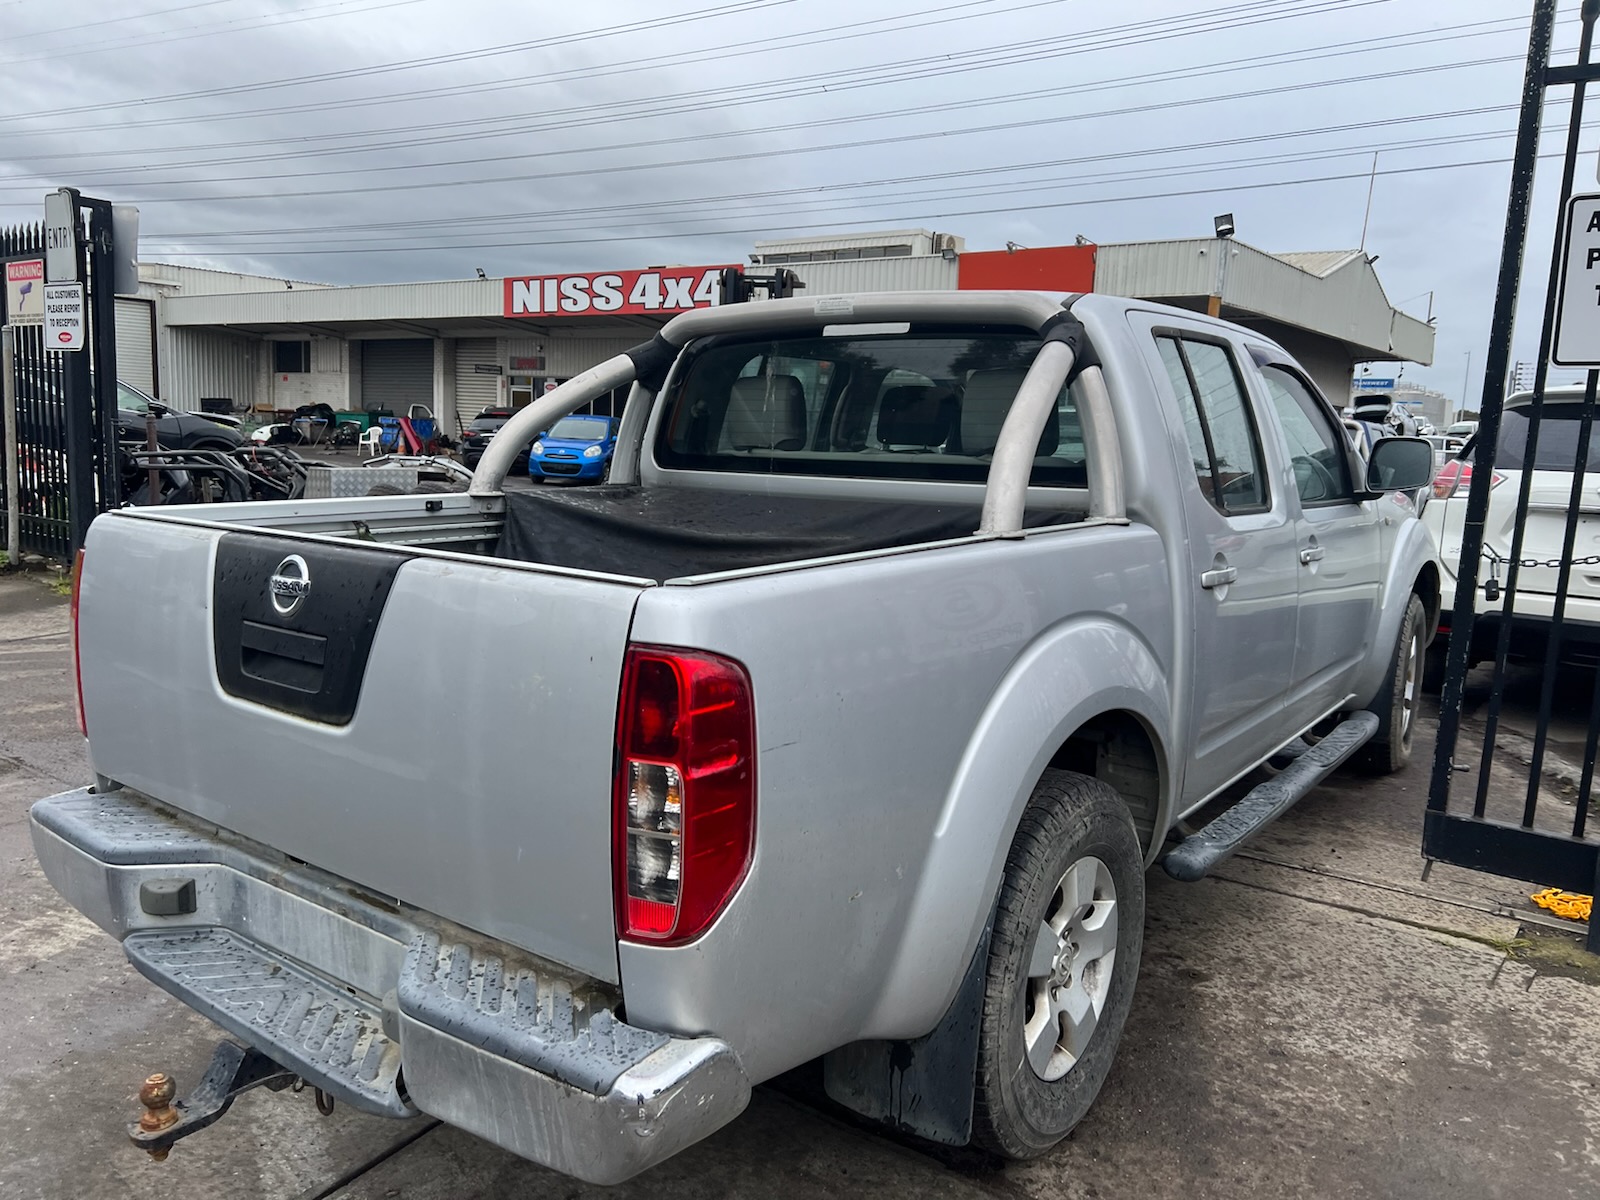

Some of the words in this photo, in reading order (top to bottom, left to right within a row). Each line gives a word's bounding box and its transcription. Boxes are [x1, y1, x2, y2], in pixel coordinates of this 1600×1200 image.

[48, 226, 72, 249] ENTRY
[9, 264, 42, 279] WARNING
[46, 290, 54, 299] ALL
[512, 274, 624, 314] NISS
[629, 269, 721, 310] 4x4
[47, 304, 63, 313] PLEASE
[64, 304, 80, 313] REPORT
[49, 318, 55, 327] TO
[56, 318, 79, 327] RECEPTION
